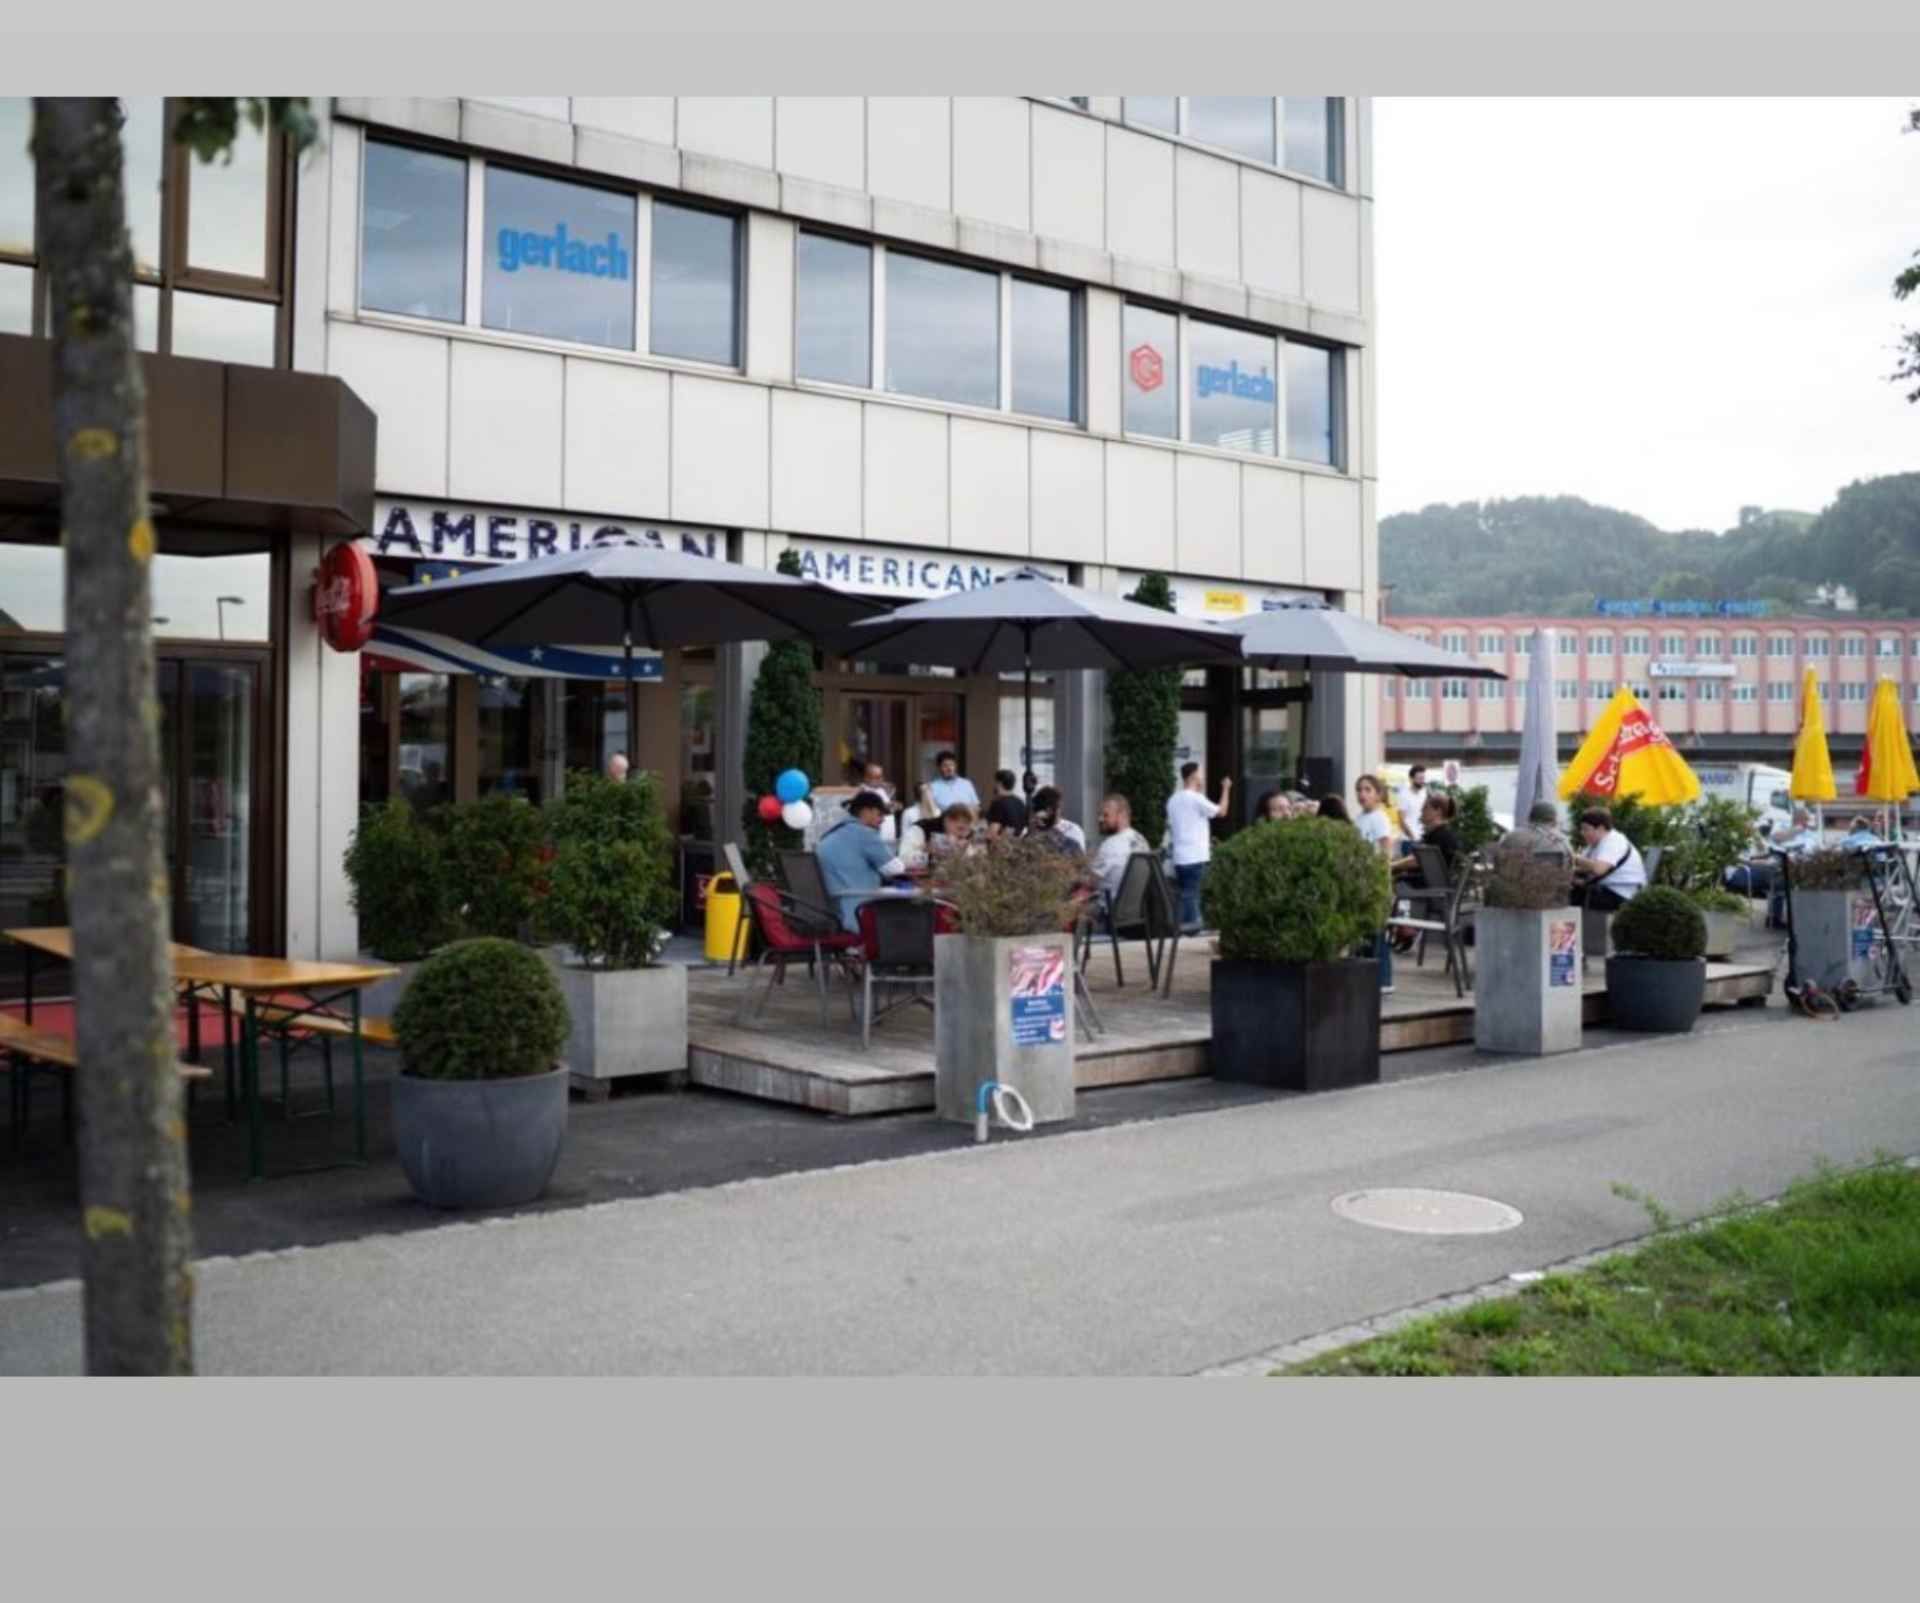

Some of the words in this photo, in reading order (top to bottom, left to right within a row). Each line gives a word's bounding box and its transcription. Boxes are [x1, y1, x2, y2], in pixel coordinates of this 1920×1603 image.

[497, 222, 628, 280] gerlach
[1197, 361, 1275, 403] gerlach
[800, 550, 991, 592] AMERICAN
